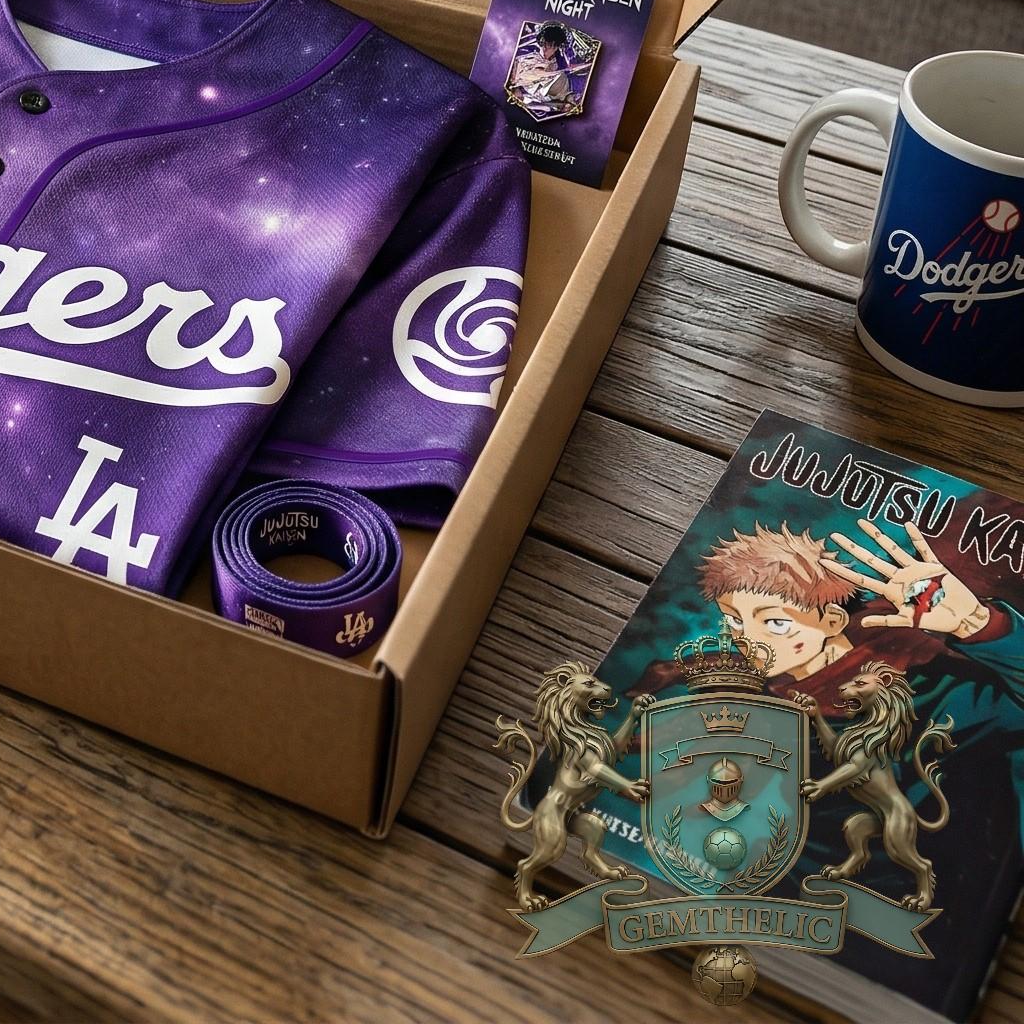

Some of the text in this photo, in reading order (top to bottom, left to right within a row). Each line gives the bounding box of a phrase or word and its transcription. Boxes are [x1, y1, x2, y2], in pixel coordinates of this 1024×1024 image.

[34, 434, 161, 586] LA
[260, 511, 319, 538] JUJUTSU
[750, 432, 957, 538] JUJUTSU
